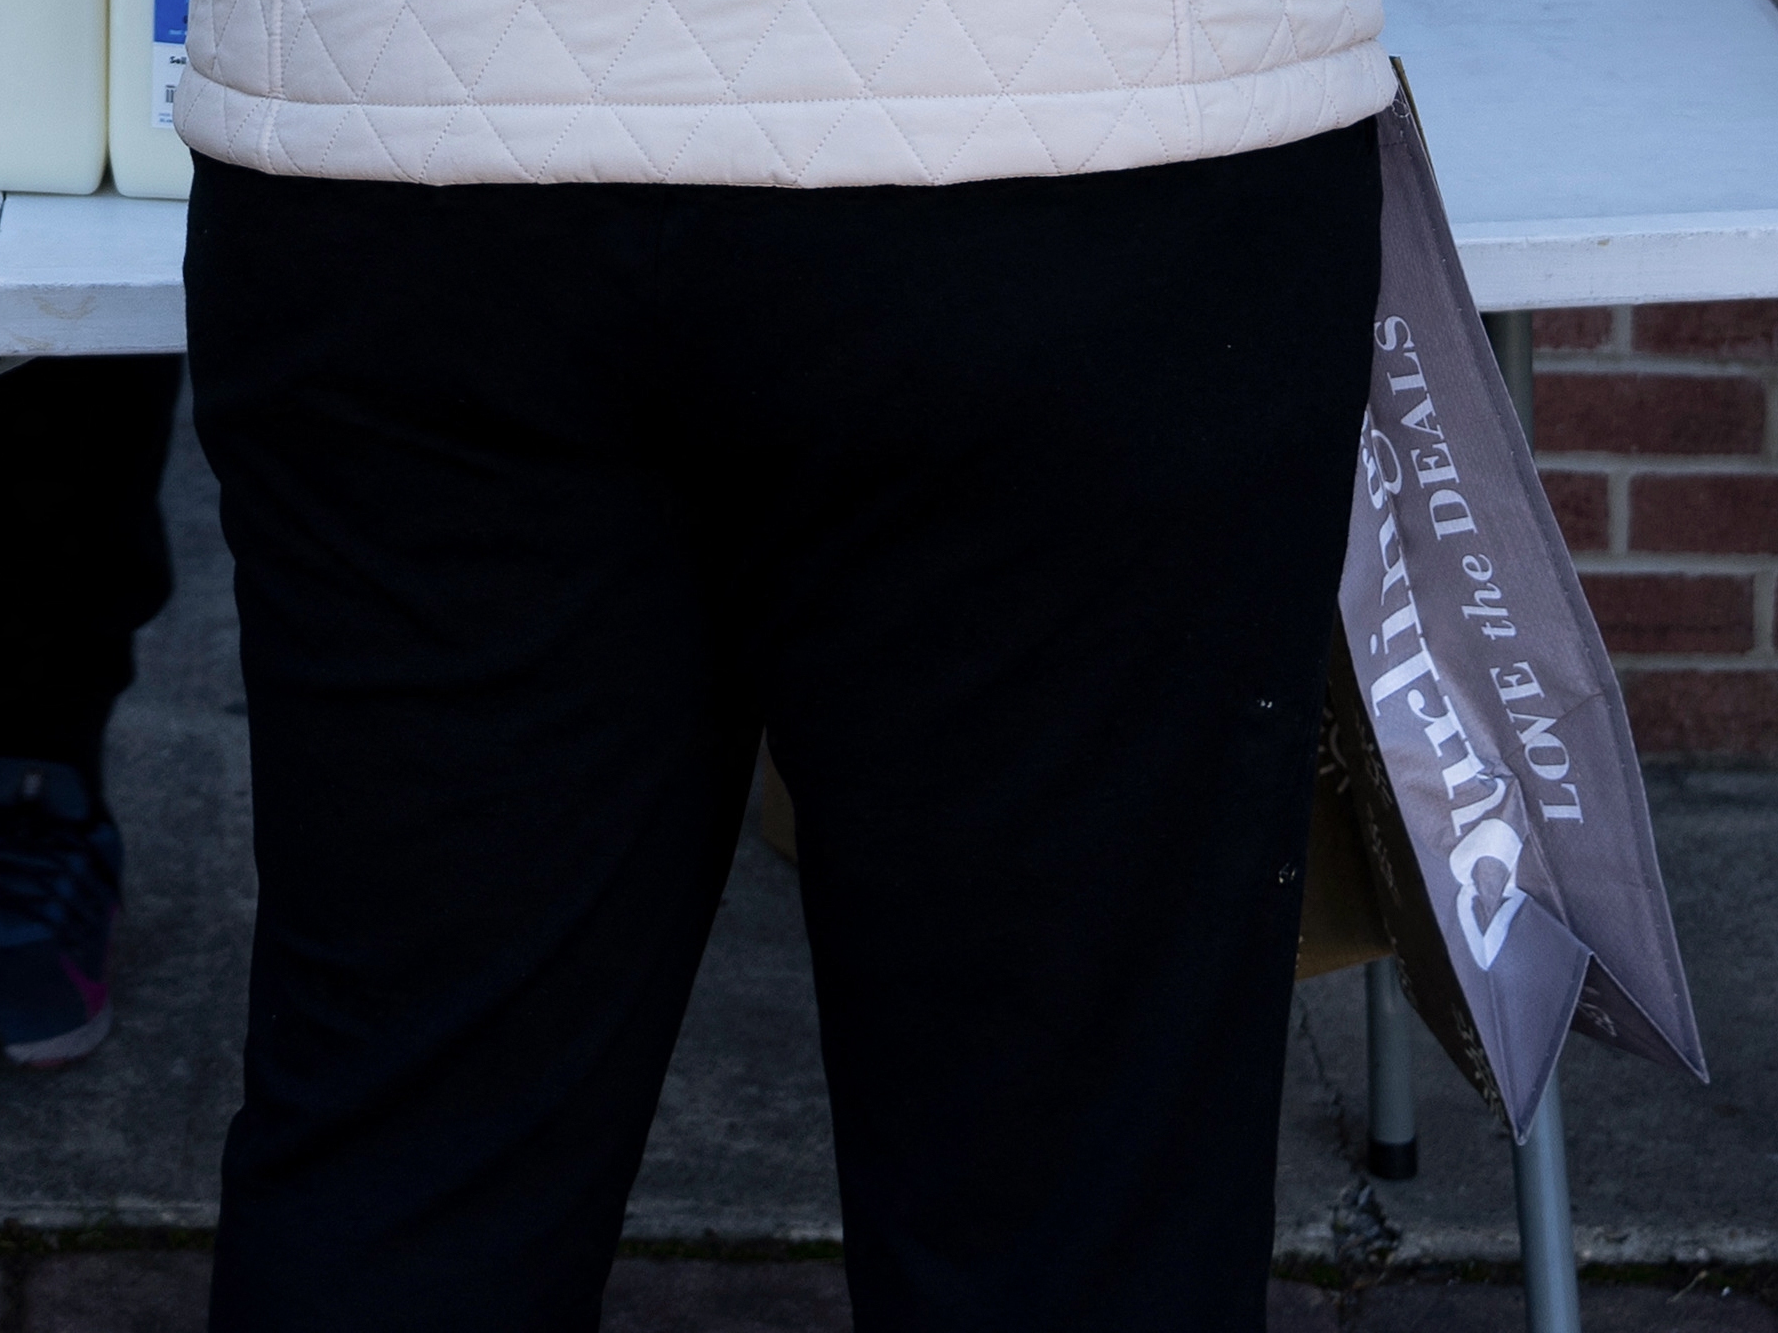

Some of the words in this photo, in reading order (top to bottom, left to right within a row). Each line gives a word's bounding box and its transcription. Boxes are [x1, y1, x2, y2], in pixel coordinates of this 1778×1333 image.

[169, 55, 187, 64] Sell
[1374, 315, 1478, 541] DEALS
[1461, 553, 1517, 641] the
[1490, 662, 1584, 825] LOVE
